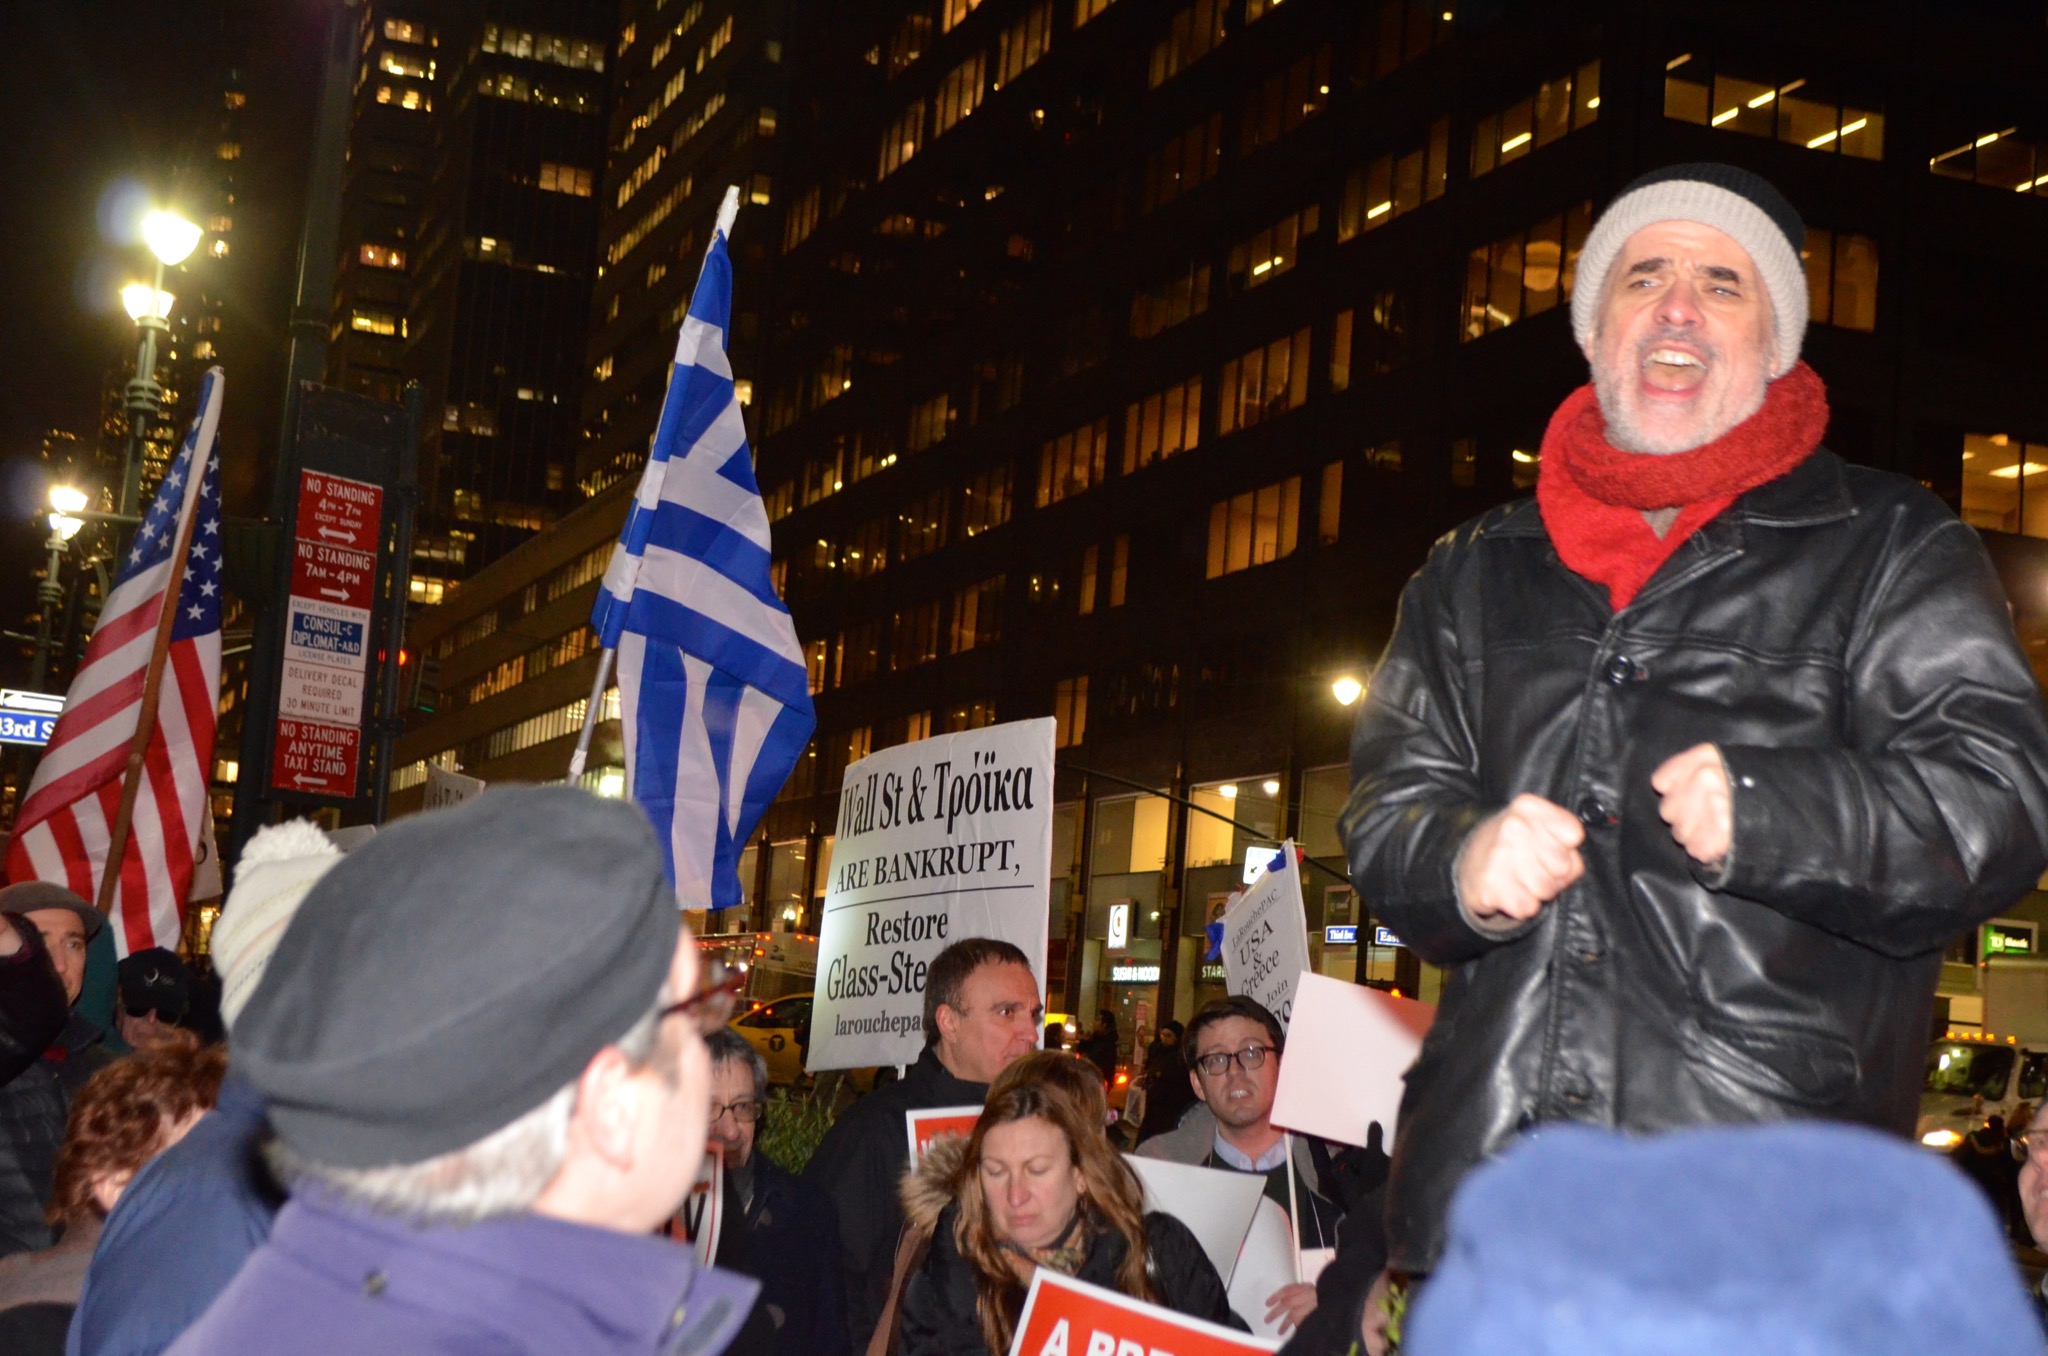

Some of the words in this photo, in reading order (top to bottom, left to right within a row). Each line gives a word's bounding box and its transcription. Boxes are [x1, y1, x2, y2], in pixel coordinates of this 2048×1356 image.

[306, 478, 322, 493] NO
[326, 481, 375, 506] STANDING
[314, 512, 336, 523] EXCEPT
[339, 518, 363, 530] SUNDAY
[298, 543, 313, 559] NO
[317, 548, 370, 570] STANDING
[305, 563, 326, 578] 7AM
[337, 570, 360, 585] 4PM
[292, 600, 315, 610] EXCEPT
[318, 605, 349, 618] VEHICLES
[303, 616, 353, 636] CONSUL-C
[293, 631, 360, 653] DIPLOMAT-A&D
[298, 651, 325, 661] LICENSE
[327, 656, 351, 665] PLATES
[288, 667, 327, 683] DELIVERY
[331, 676, 357, 688] DECAL
[302, 685, 342, 700] REQUIRED
[286, 697, 298, 709] 30
[301, 700, 330, 714] MINUTE
[334, 705, 355, 717] LIMIT
[0, 716, 36, 738] 3rd
[280, 723, 296, 737] NO
[301, 726, 354, 746] STANDING
[288, 741, 344, 760] ANYTIME
[284, 755, 308, 770] TAXI
[312, 759, 347, 776] STAND
[840, 773, 878, 840] Wall
[879, 771, 903, 830] St
[906, 766, 927, 824] &
[835, 859, 869, 894] ARE
[872, 840, 1020, 886] BANKRUPT,
[865, 912, 948, 946] Restore
[1232, 888, 1278, 948] LaRouchePAC
[1240, 920, 1274, 966] USA
[1990, 936, 2003, 947] TD
[1253, 952, 1263, 970] &
[1241, 949, 1279, 997] Greece
[1265, 978, 1289, 1007] Join
